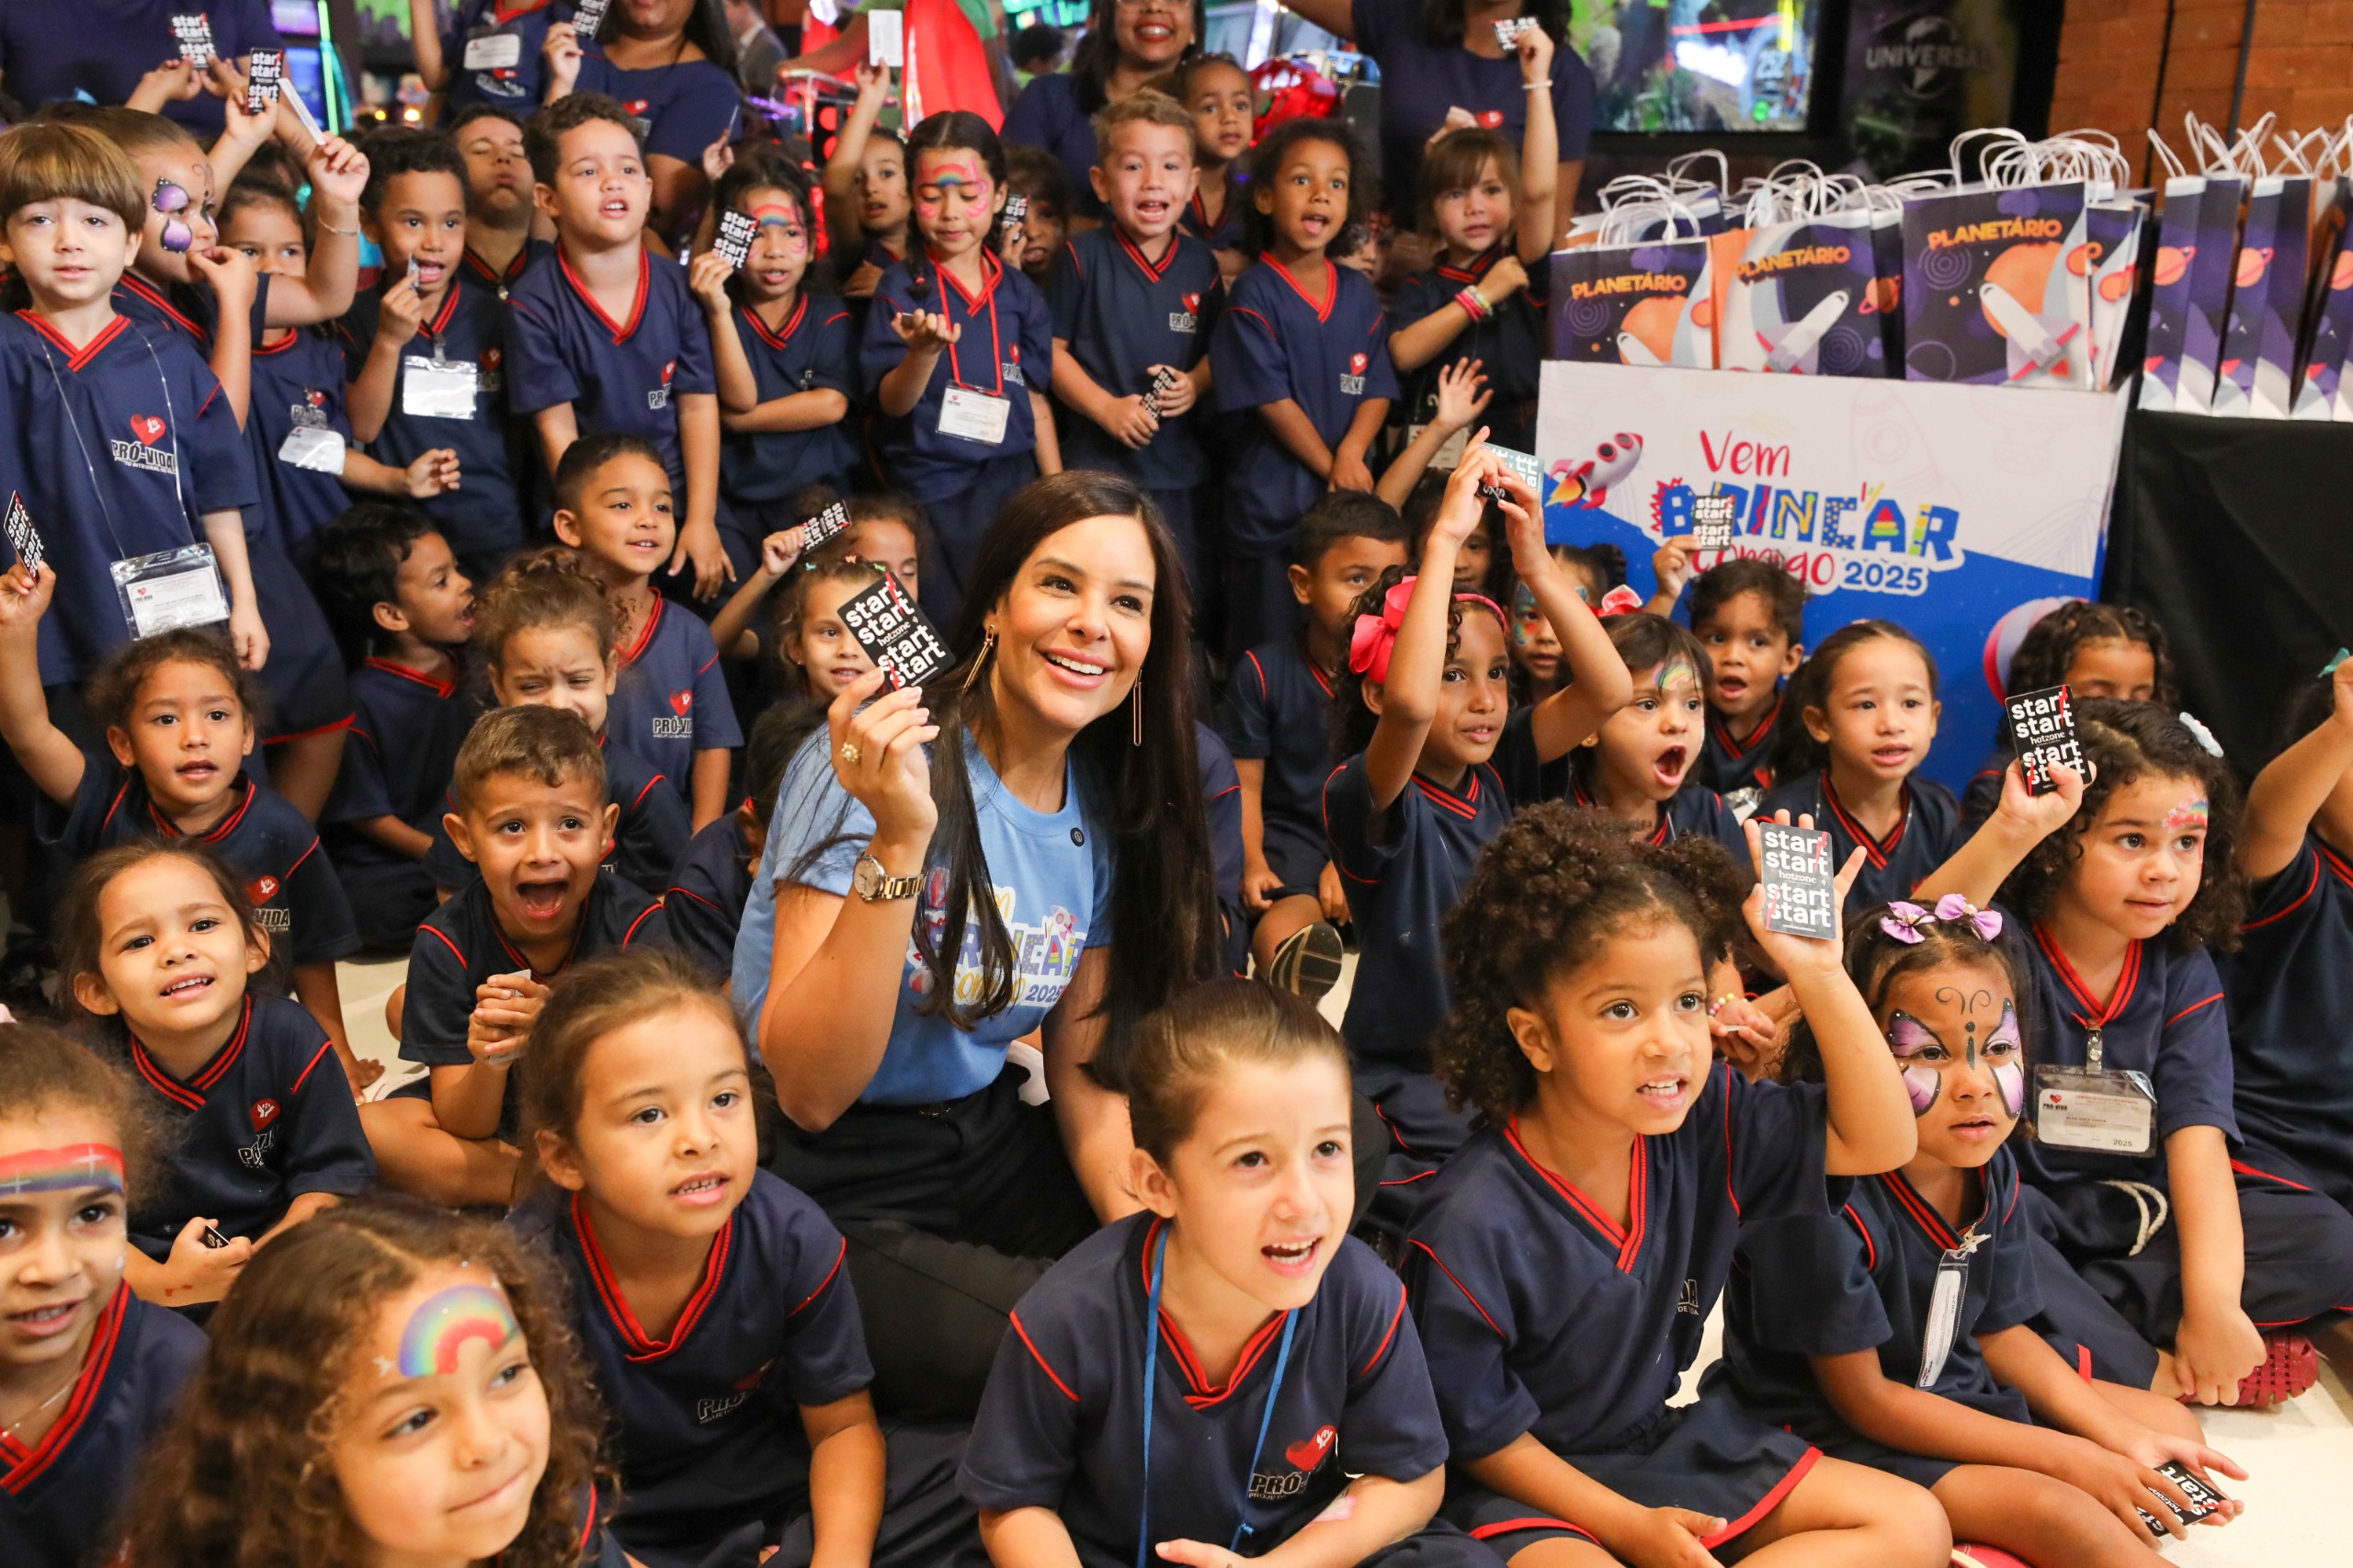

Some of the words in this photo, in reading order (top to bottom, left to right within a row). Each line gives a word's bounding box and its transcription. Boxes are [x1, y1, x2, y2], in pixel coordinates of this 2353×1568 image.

[250, 65, 280, 77] start
[721, 222, 754, 243] start
[1927, 215, 2063, 251] PLANETÁRIO
[714, 238, 748, 258] start
[1736, 245, 1851, 279] PLANETÁRIO
[1571, 271, 1688, 301] PLANETÁRIO
[110, 438, 176, 471] PRÓ-VIDA
[1699, 430, 1790, 477] Vem
[823, 508, 839, 535] start
[1652, 479, 1960, 562] BRINCAR
[1695, 508, 1733, 519] start
[15, 509, 28, 549] start
[808, 517, 824, 544] start
[1700, 535, 1730, 546] tart
[24, 528, 39, 567] start
[1844, 561, 1923, 590] 2025
[846, 581, 903, 627] start
[858, 597, 915, 644] start
[877, 620, 911, 647] hotzone
[878, 625, 935, 671] start
[890, 641, 946, 687] start
[2011, 691, 2070, 720] start
[2016, 709, 2075, 738] start
[2030, 731, 2065, 745] hotzone
[2022, 739, 2082, 767] start
[2027, 756, 2086, 785] strt
[1765, 831, 1827, 856] start
[1766, 850, 1828, 876] start
[1779, 869, 1816, 883] hotzone
[1767, 882, 1830, 908] start
[1768, 902, 1831, 928] start
[2113, 1139, 2133, 1147] 2025
[2161, 1466, 2219, 1510] start
